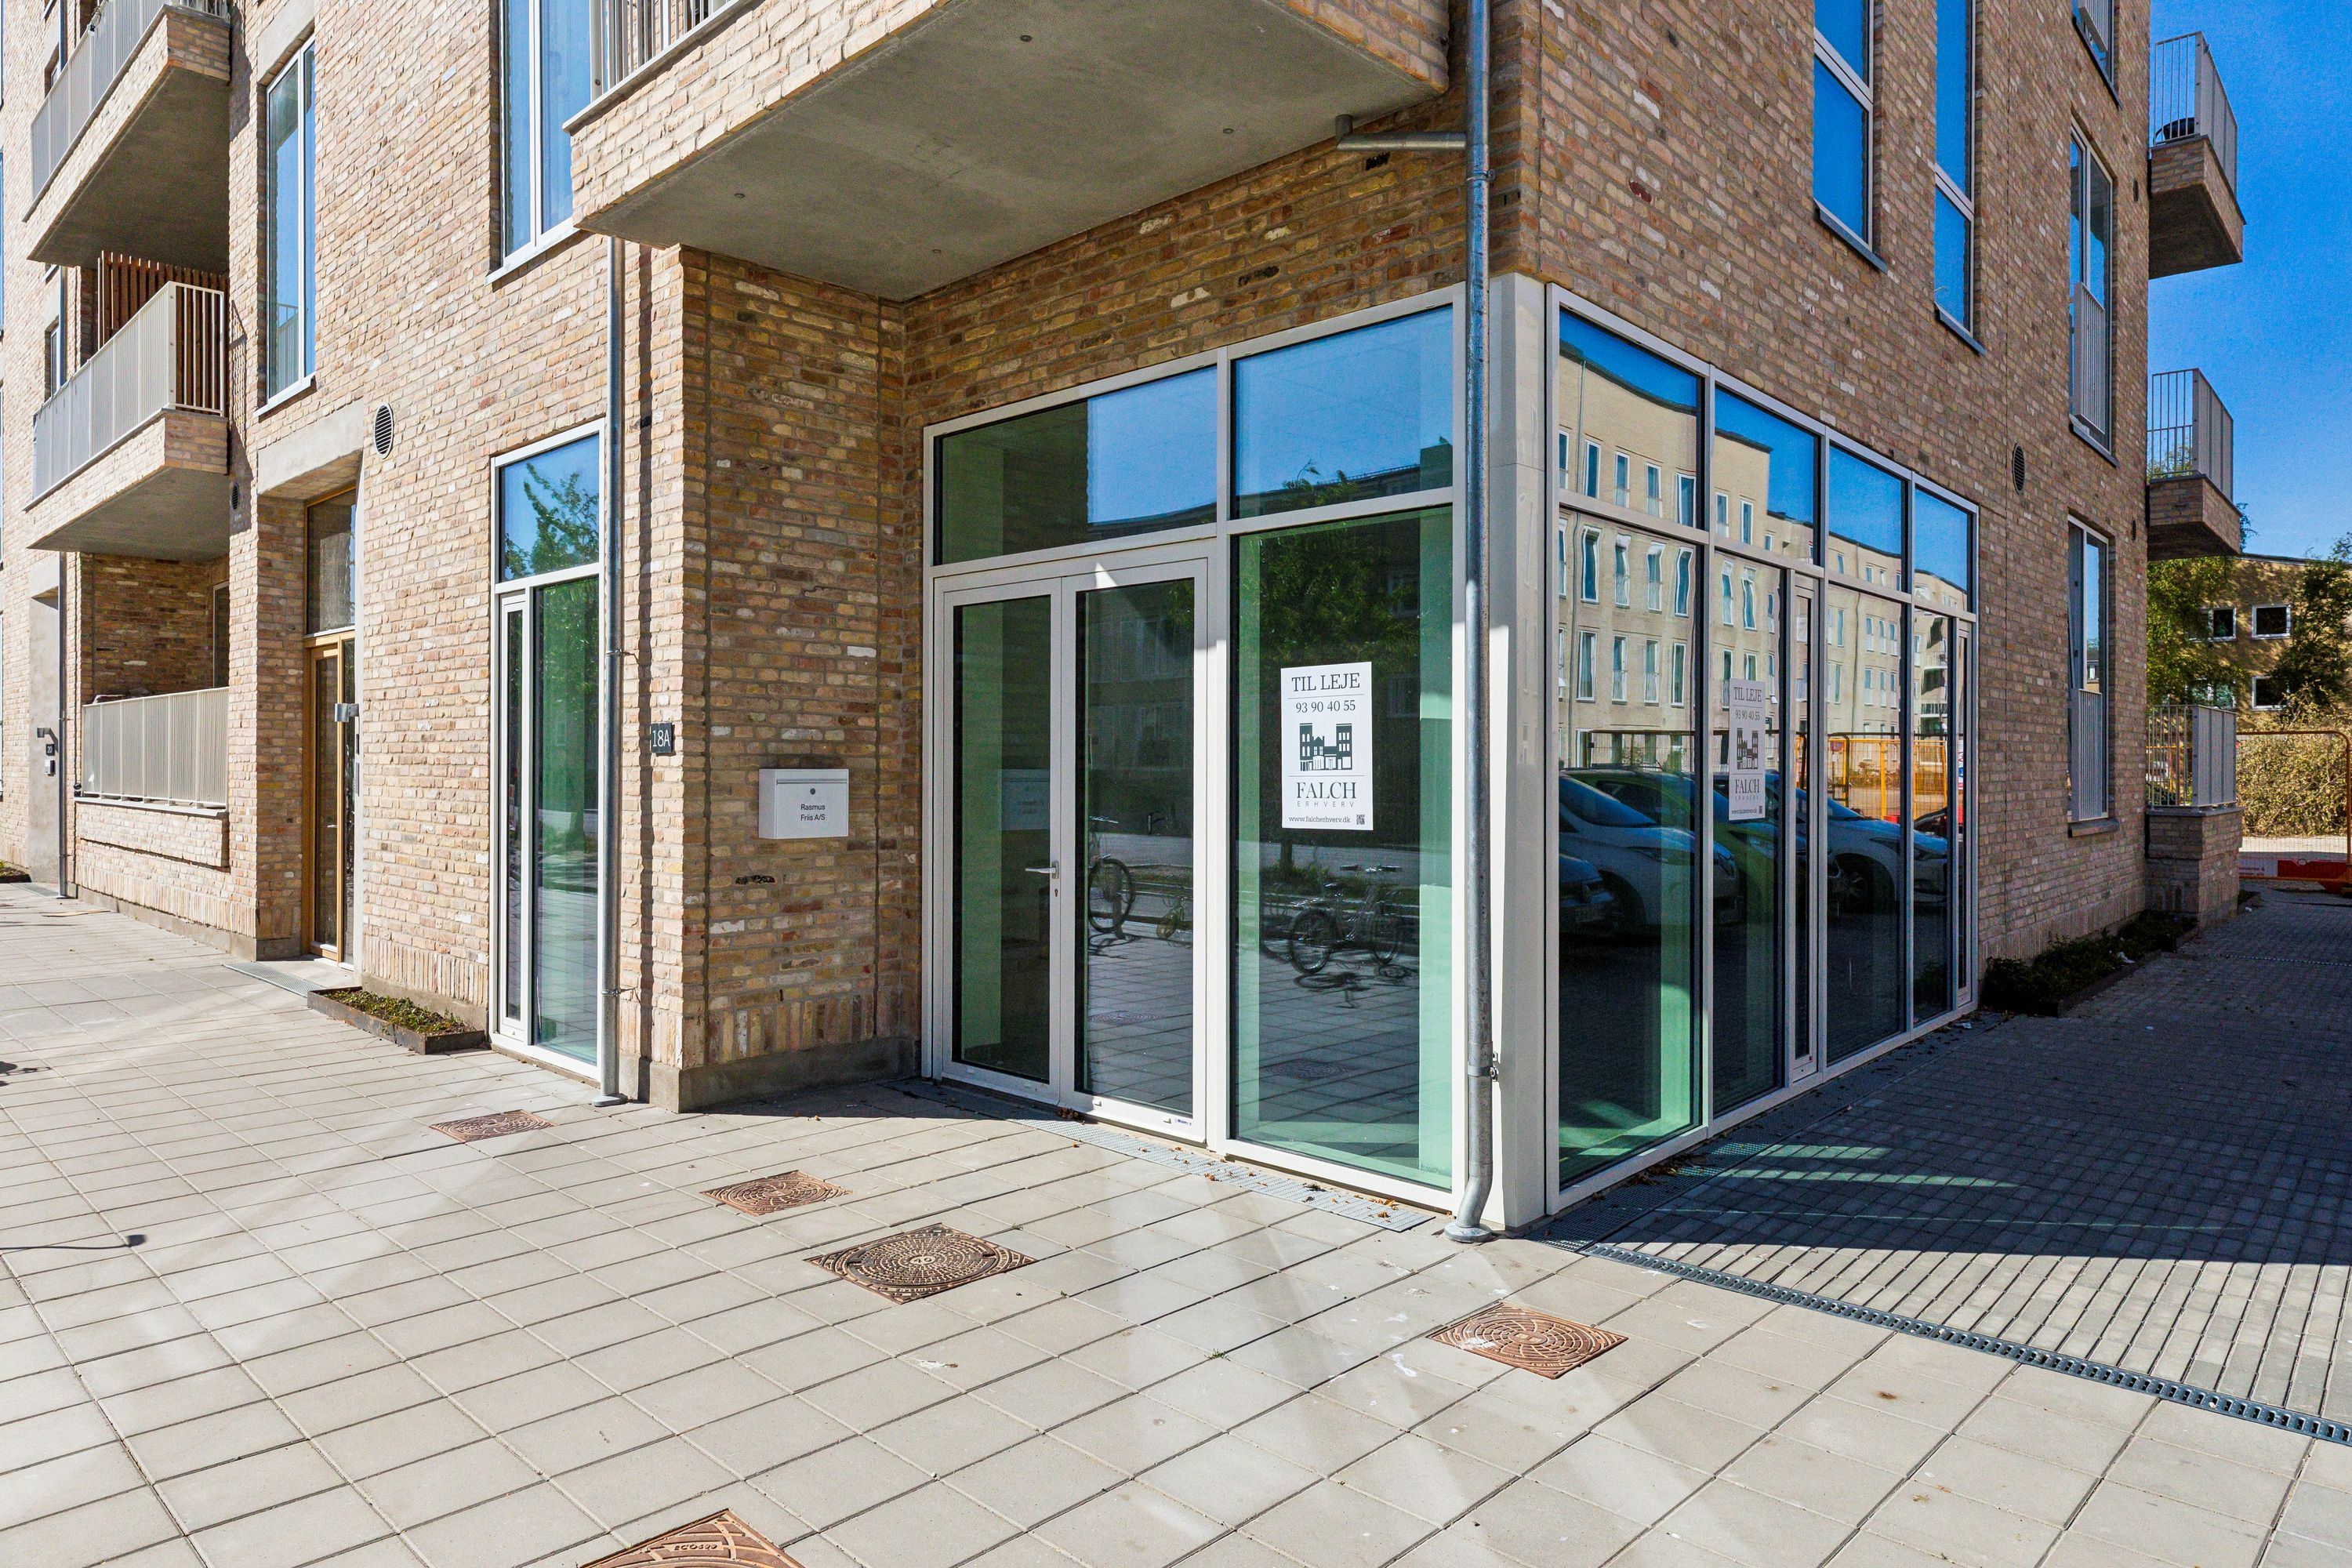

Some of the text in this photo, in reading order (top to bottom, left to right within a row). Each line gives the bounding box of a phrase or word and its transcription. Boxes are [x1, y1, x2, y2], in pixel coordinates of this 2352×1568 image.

[1291, 673, 1360, 691] TIL LEJE
[1733, 687, 1762, 702] TIL LEJE
[1295, 699, 1356, 713] 93 90 40 55
[1735, 710, 1760, 721] 93 90 40 55
[652, 729, 670, 747] 18A
[1296, 782, 1356, 799] FALCH
[1735, 779, 1760, 794] FALCH
[1288, 815, 1351, 824] www.falcherhverv.dk
